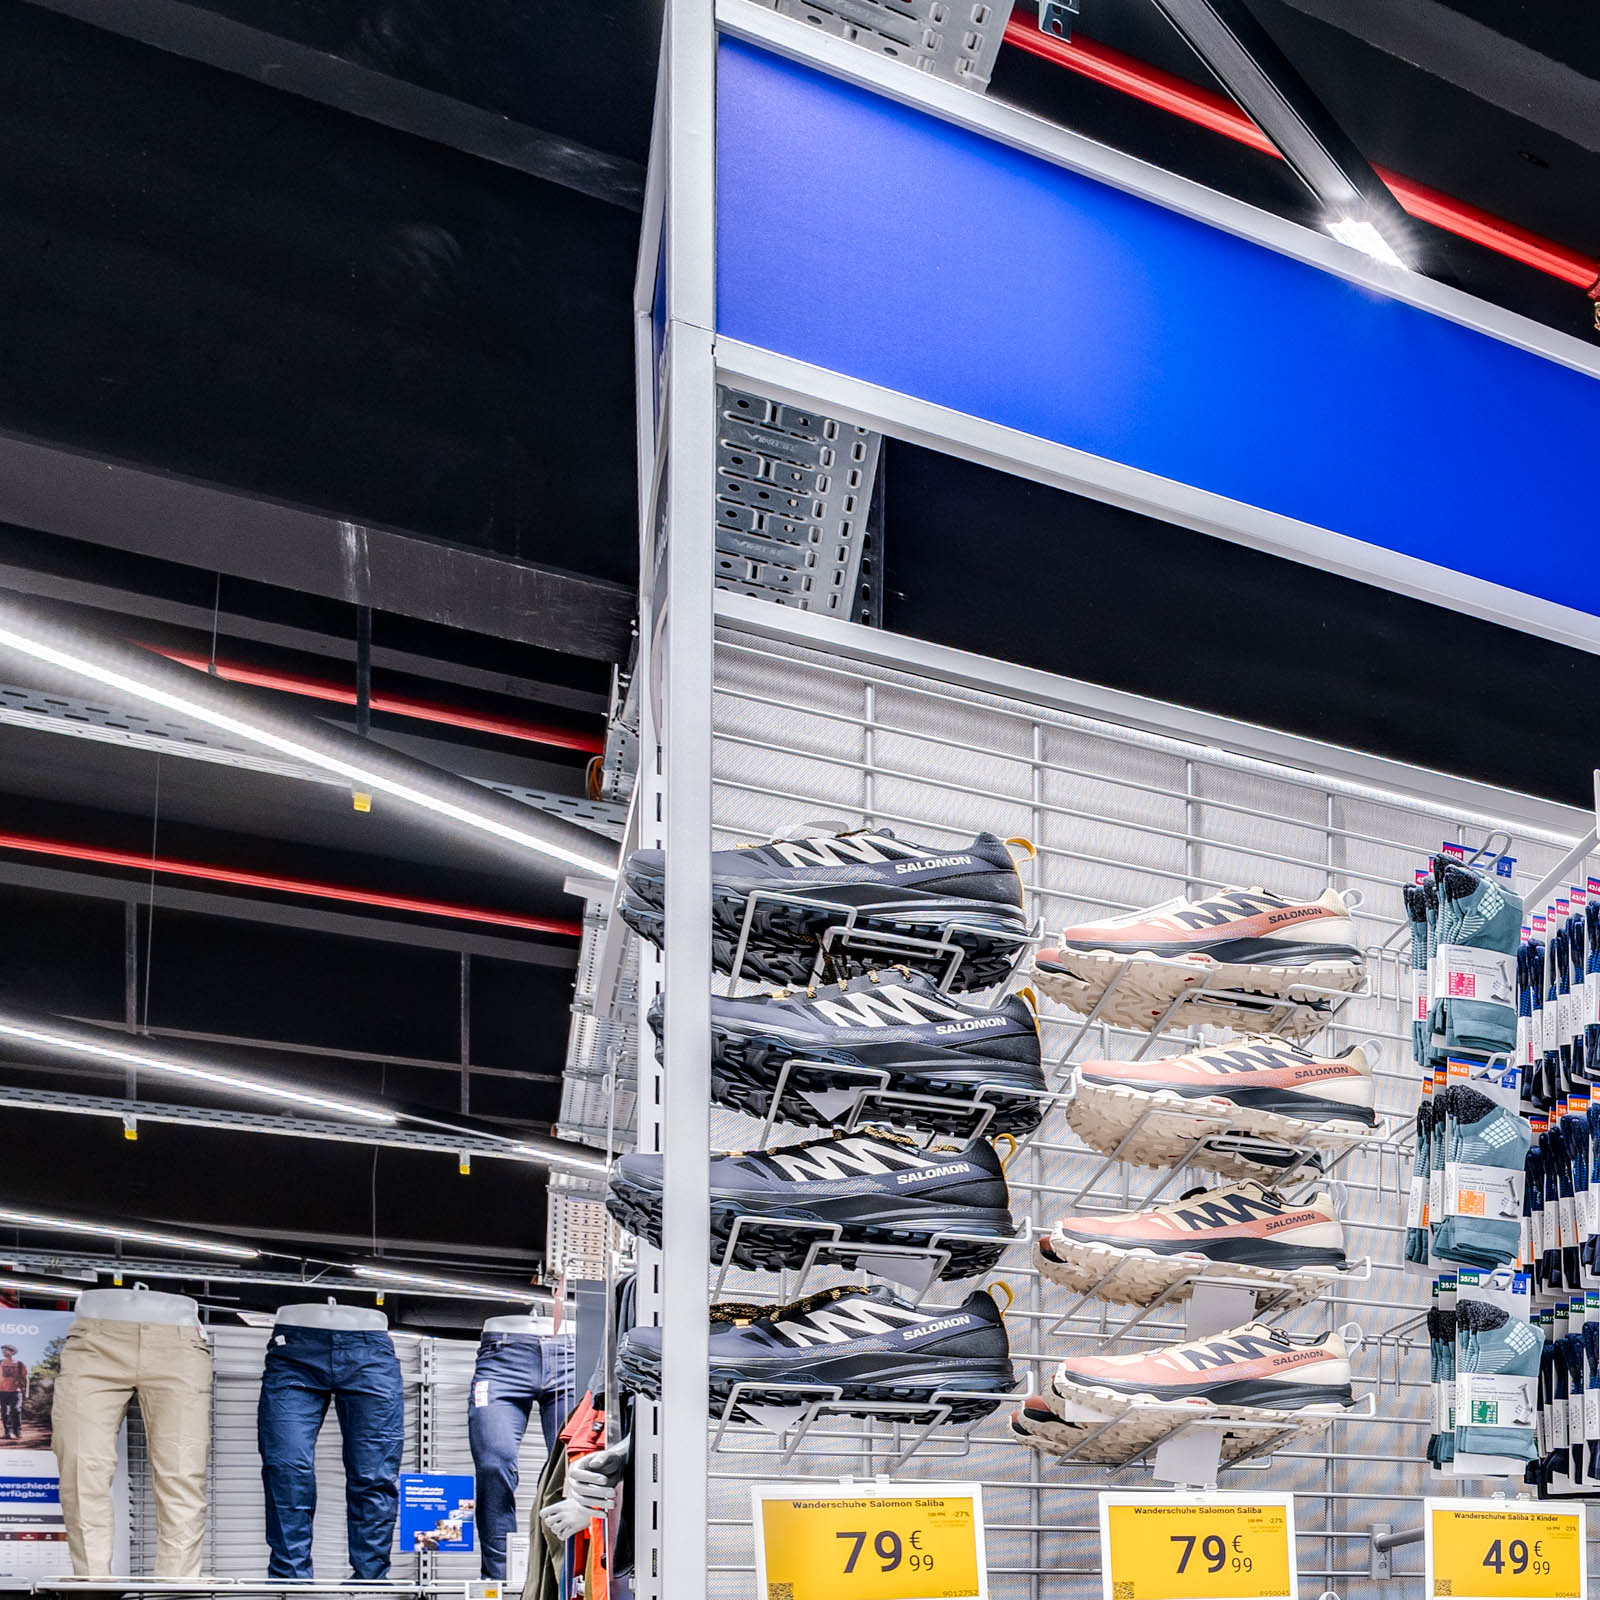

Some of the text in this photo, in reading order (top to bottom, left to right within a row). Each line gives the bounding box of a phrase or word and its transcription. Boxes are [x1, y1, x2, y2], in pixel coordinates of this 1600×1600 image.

[895, 854, 972, 875] SALOMON
[1268, 906, 1323, 924] SALOMON
[935, 1016, 1007, 1036] SALOMON
[1294, 1065, 1349, 1080] SALOMON
[896, 1162, 970, 1185] SALOMON
[1265, 1212, 1315, 1232] SALOMON
[902, 1314, 971, 1341] SALOMON
[1271, 1348, 1324, 1367] SALOMON
[792, 1499, 945, 1509] Wanderschuhe Salomon Saliba
[1134, 1506, 1196, 1514] Wanderschuhe
[1454, 1512, 1506, 1520] Wanderschuhe
[1507, 1513, 1529, 1521] Saliba
[909, 1530, 924, 1551] €
[1232, 1535, 1244, 1553] €
[1534, 1540, 1543, 1557] €
[835, 1530, 902, 1574] 79
[1170, 1534, 1227, 1574] 79
[1482, 1539, 1529, 1575] 49
[909, 1554, 934, 1571] 99
[1232, 1557, 1253, 1573] 99
[1533, 1561, 1550, 1575] 99
